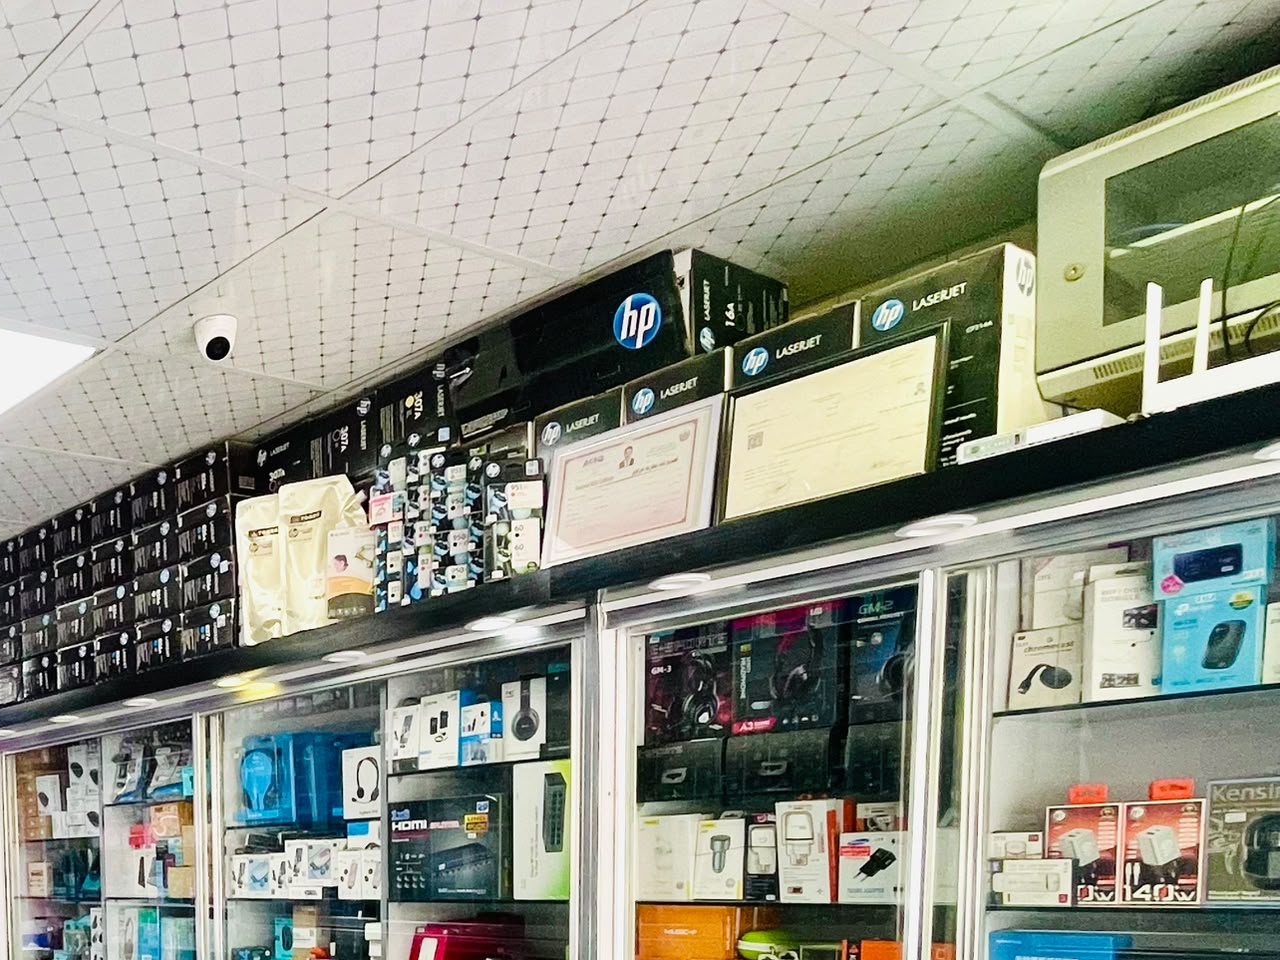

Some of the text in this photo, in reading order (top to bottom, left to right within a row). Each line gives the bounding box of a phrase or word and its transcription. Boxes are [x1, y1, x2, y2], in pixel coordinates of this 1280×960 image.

[703, 279, 711, 321] LASERJET
[725, 303, 735, 327] 16A
[873, 282, 967, 331] hp LASERJET
[620, 294, 657, 348] hp
[743, 335, 822, 375] hp LASERJET
[357, 398, 370, 417] hp
[437, 385, 445, 417] LASERJET
[632, 377, 698, 414] hp LASERJET
[541, 413, 600, 445] hp LASERJET
[392, 819, 427, 831] HDMI
